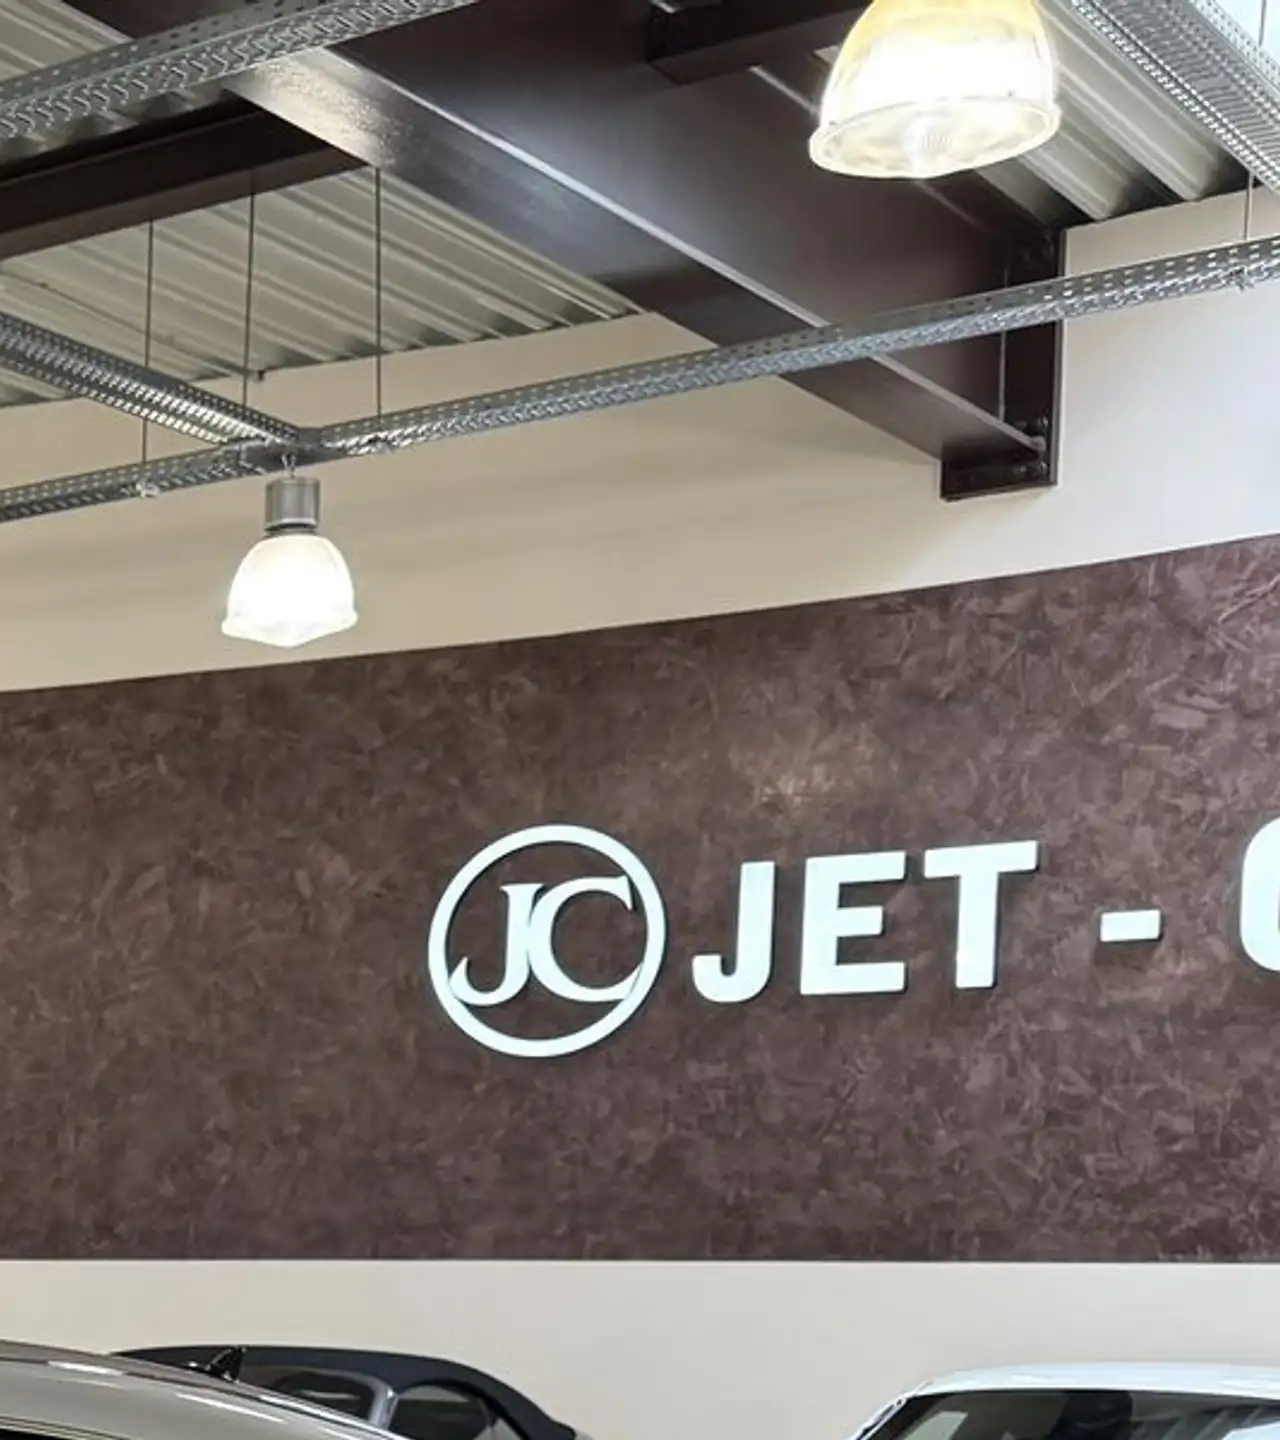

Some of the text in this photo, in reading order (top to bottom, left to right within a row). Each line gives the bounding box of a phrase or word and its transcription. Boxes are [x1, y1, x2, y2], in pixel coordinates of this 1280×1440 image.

[447, 872, 645, 1010] JC
[692, 840, 1161, 1003] JET -
